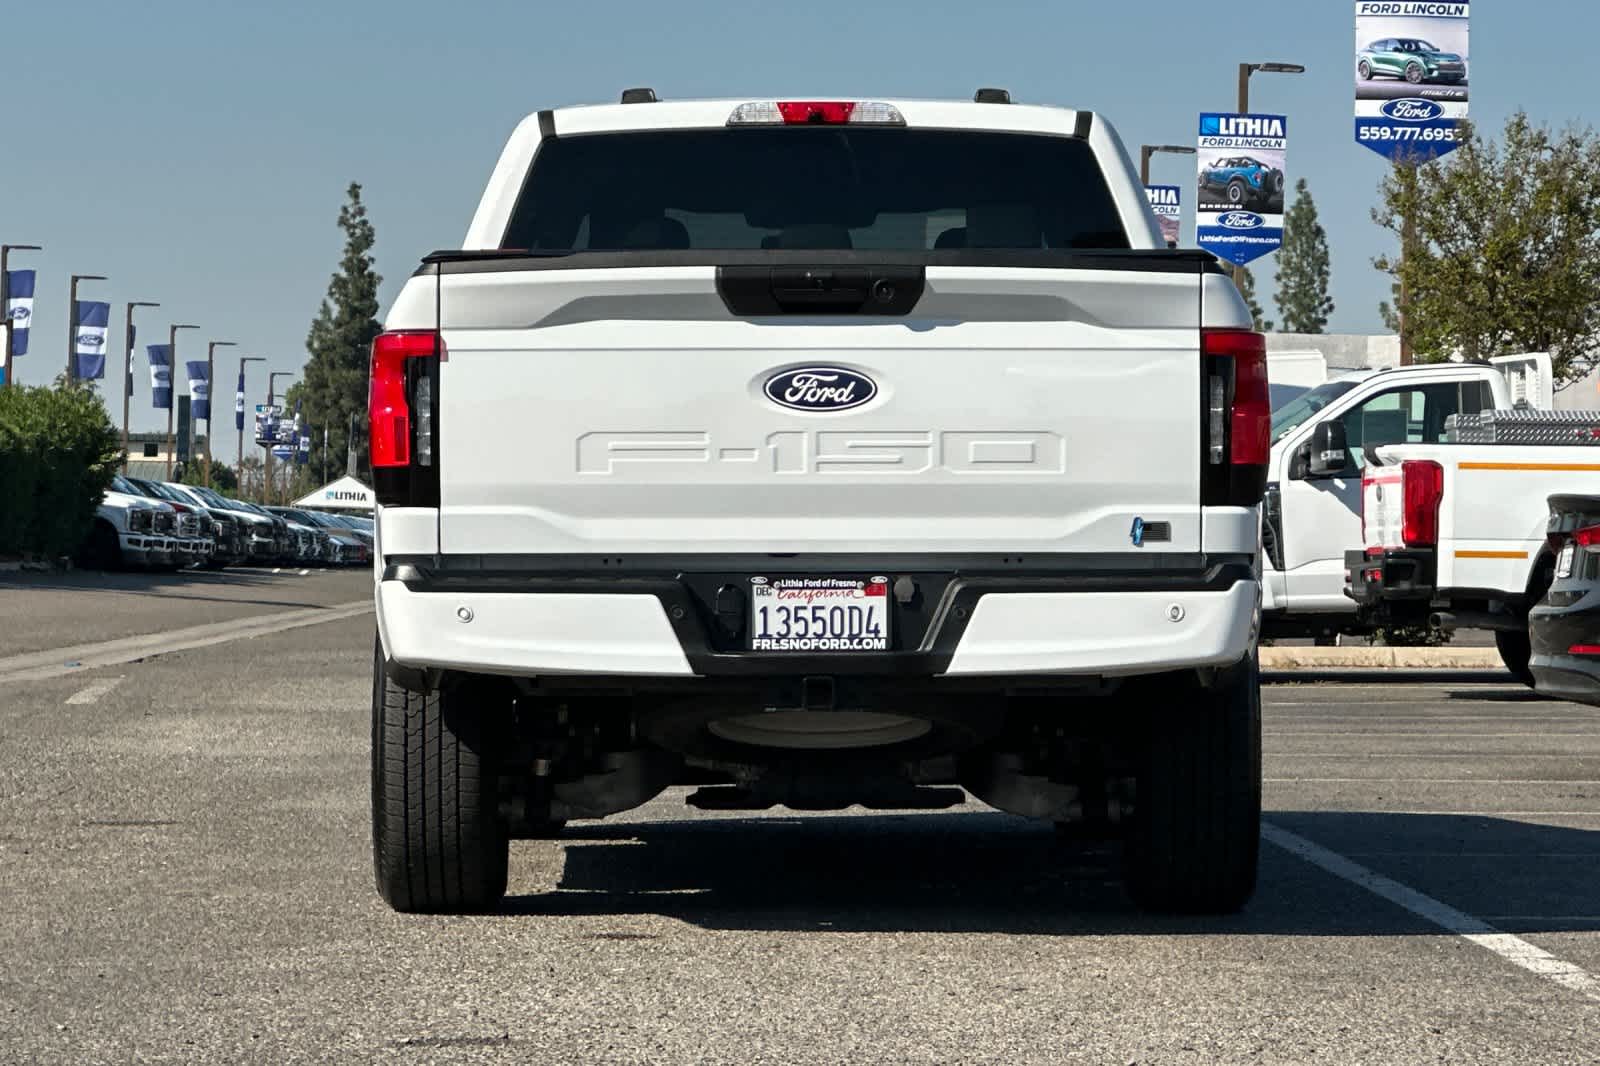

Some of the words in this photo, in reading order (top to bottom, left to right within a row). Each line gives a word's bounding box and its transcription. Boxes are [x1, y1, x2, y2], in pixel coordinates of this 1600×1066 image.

[1361, 3, 1401, 14] FORD
[1403, 3, 1465, 15] LINCOLN
[1392, 100, 1432, 118] Ford
[1219, 117, 1283, 136] LITHIA
[1201, 137, 1233, 147] FORD
[1235, 138, 1282, 148] LINCOLN
[1144, 188, 1178, 204] HIA
[1224, 213, 1256, 227] Ford
[784, 373, 855, 403] Ford
[575, 429, 1067, 476] F-150
[334, 491, 367, 502] LITHIA
[781, 579, 803, 588] Lithia
[803, 579, 821, 588] Ford
[821, 579, 831, 588] of
[831, 579, 857, 588] Fresno
[756, 587, 772, 597] DEC
[777, 589, 864, 604] California
[757, 605, 881, 638] 13550D4
[752, 638, 886, 650] FRESNOFORD.COM
